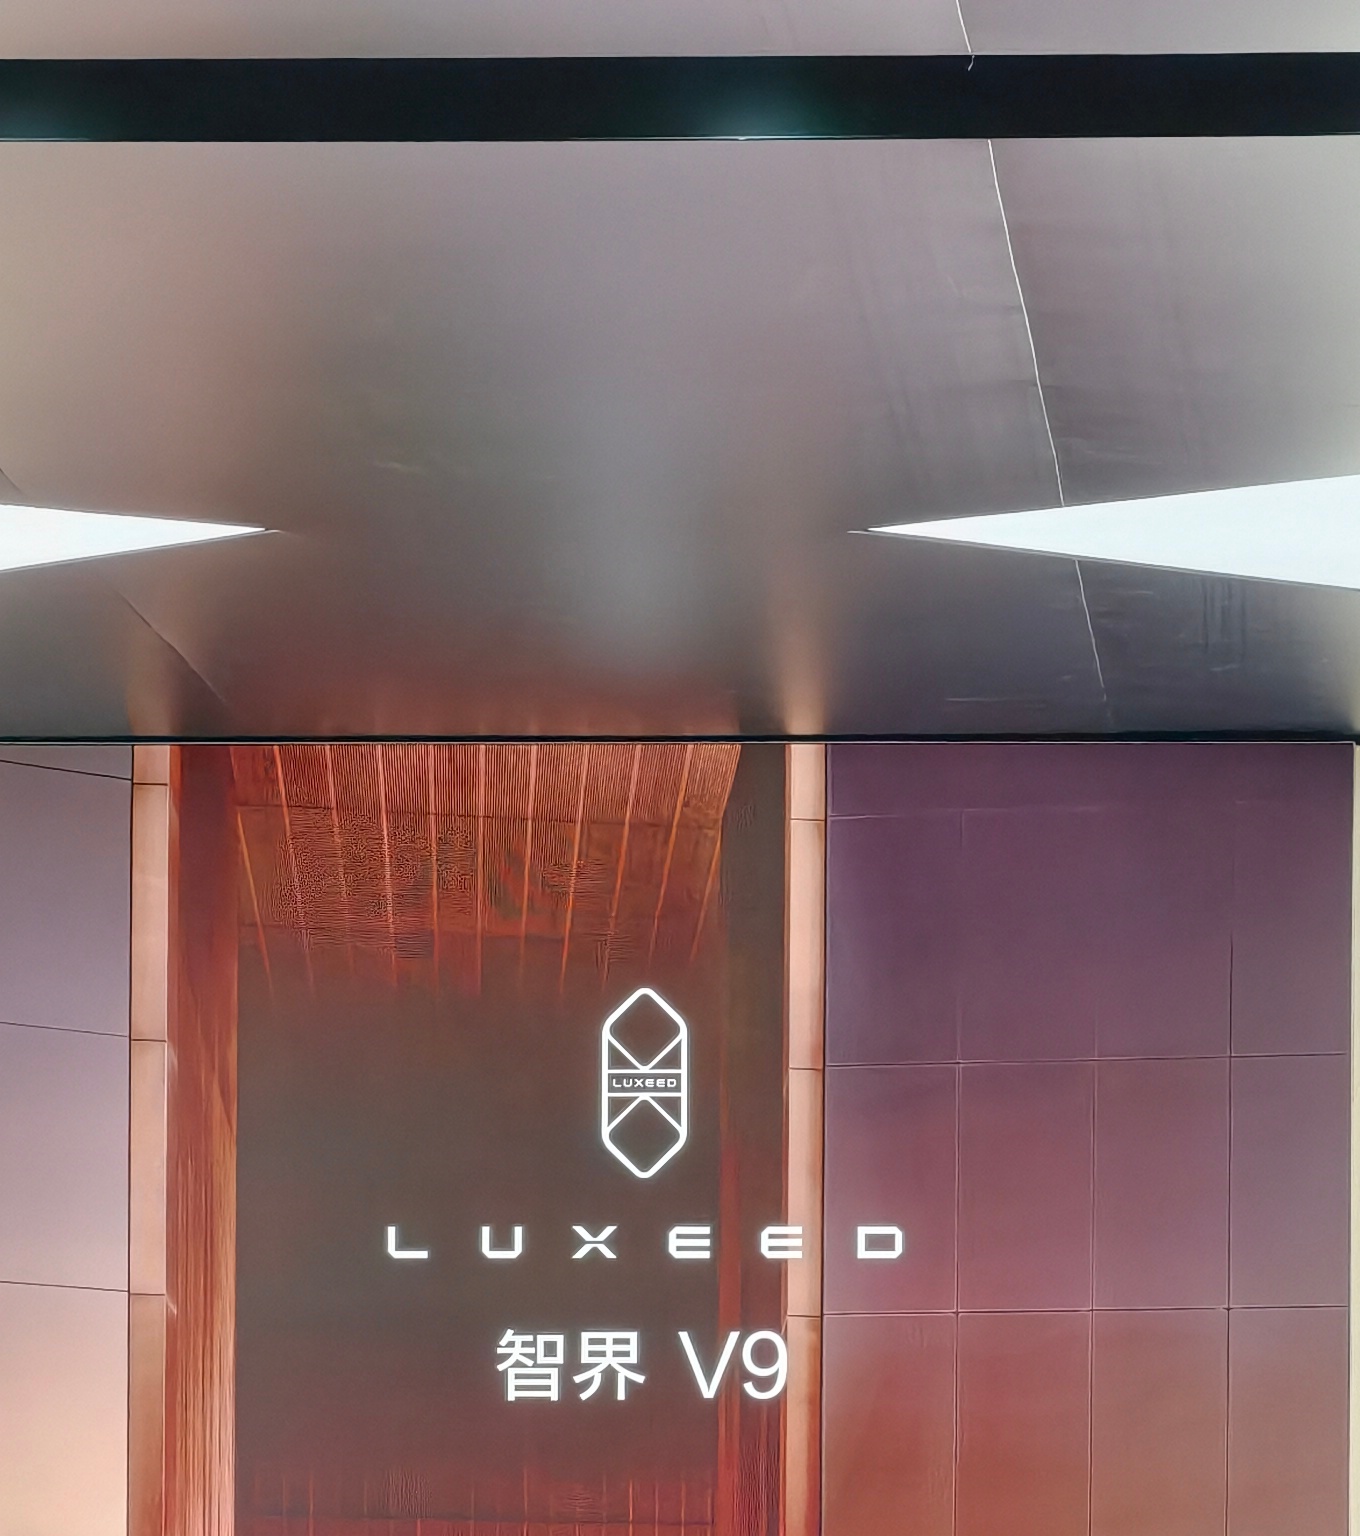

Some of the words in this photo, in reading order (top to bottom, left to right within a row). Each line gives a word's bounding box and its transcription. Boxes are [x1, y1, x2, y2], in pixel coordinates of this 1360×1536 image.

[612, 1078, 677, 1088] LUXEED
[386, 1225, 903, 1259] LUXEED
[496, 1328, 647, 1402] 智界
[677, 1330, 789, 1401] V9
